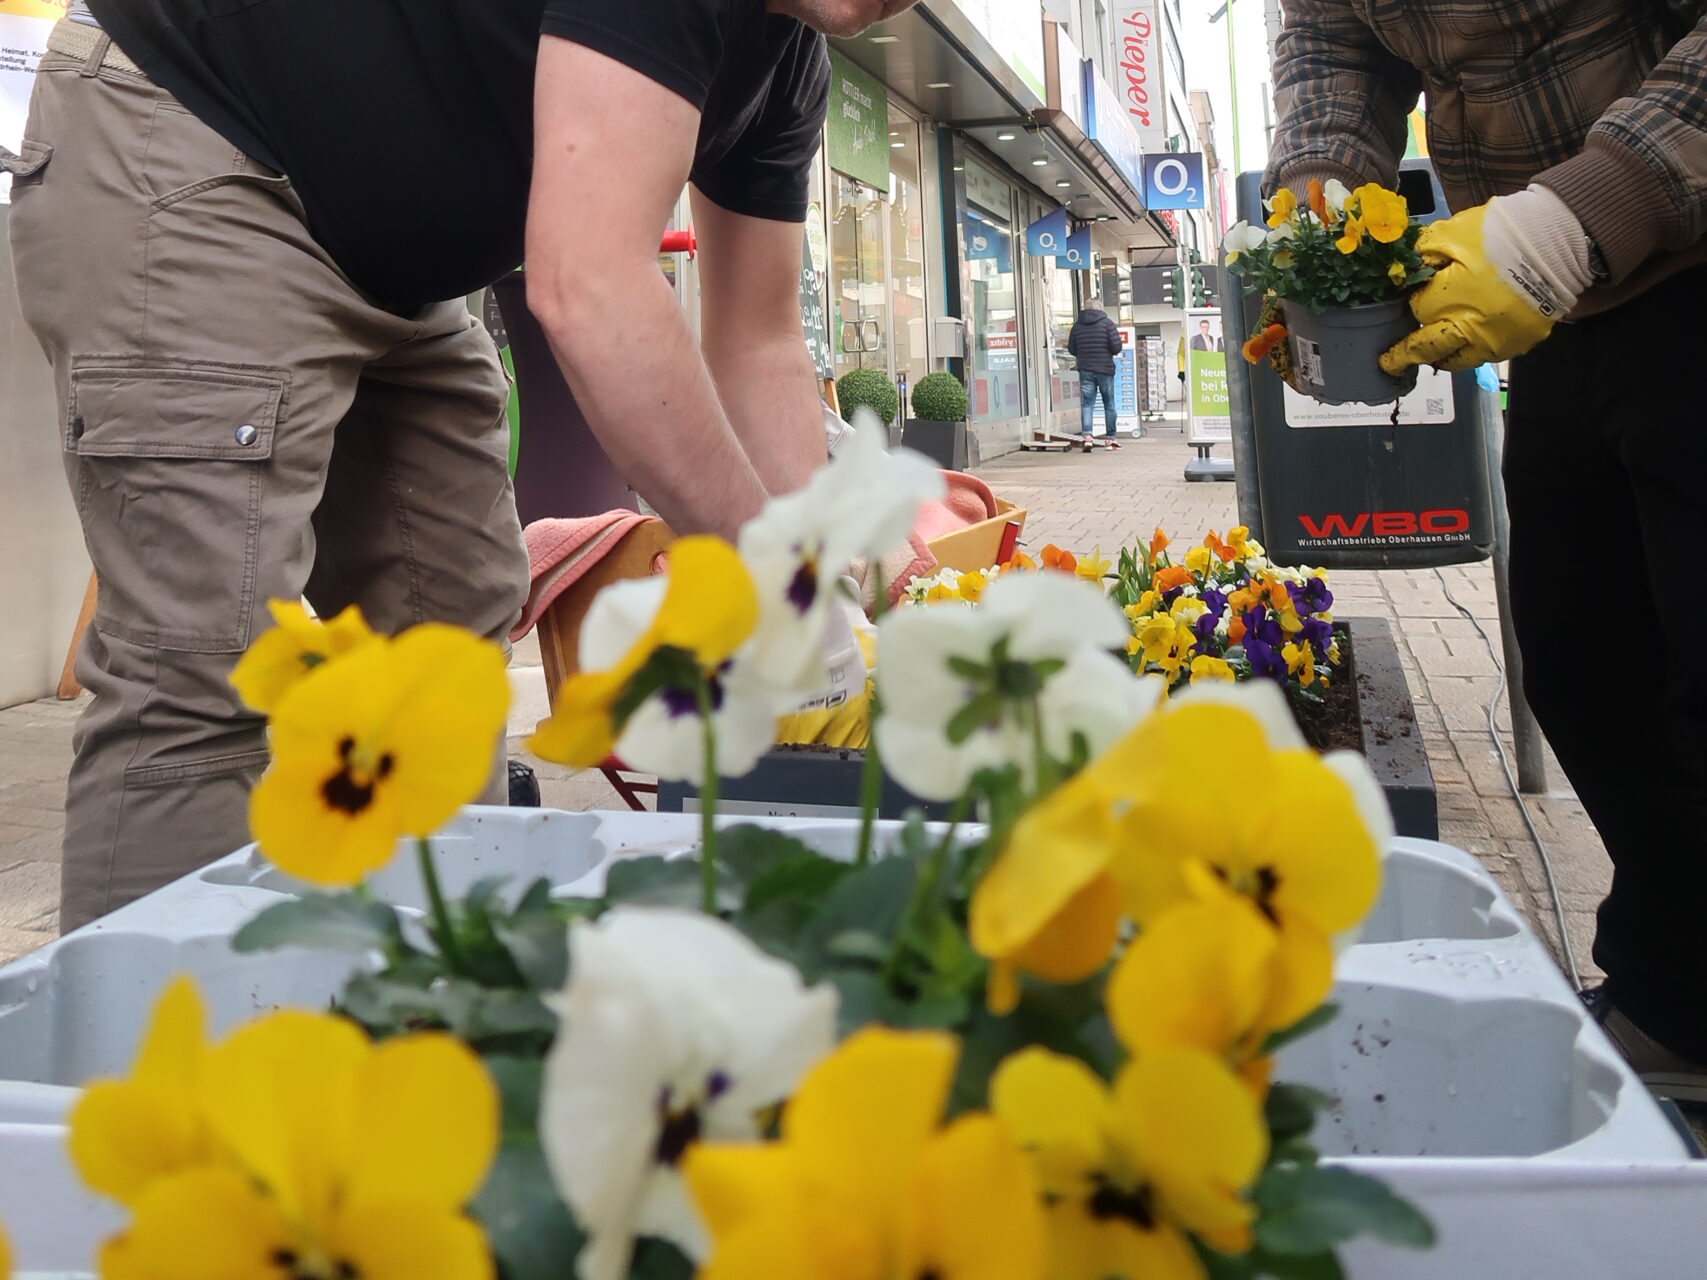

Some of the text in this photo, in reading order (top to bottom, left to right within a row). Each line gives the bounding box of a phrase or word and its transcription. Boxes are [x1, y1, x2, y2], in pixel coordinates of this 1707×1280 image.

[1120, 11, 1152, 127] Pieper
[1201, 380, 1218, 391] bei
[1293, 410, 1410, 420] www.sauberes-oberhausede
[1297, 508, 1470, 538] WBO
[1298, 532, 1471, 547] Wirtschaftsbetriebe Oberhausen GmbH
